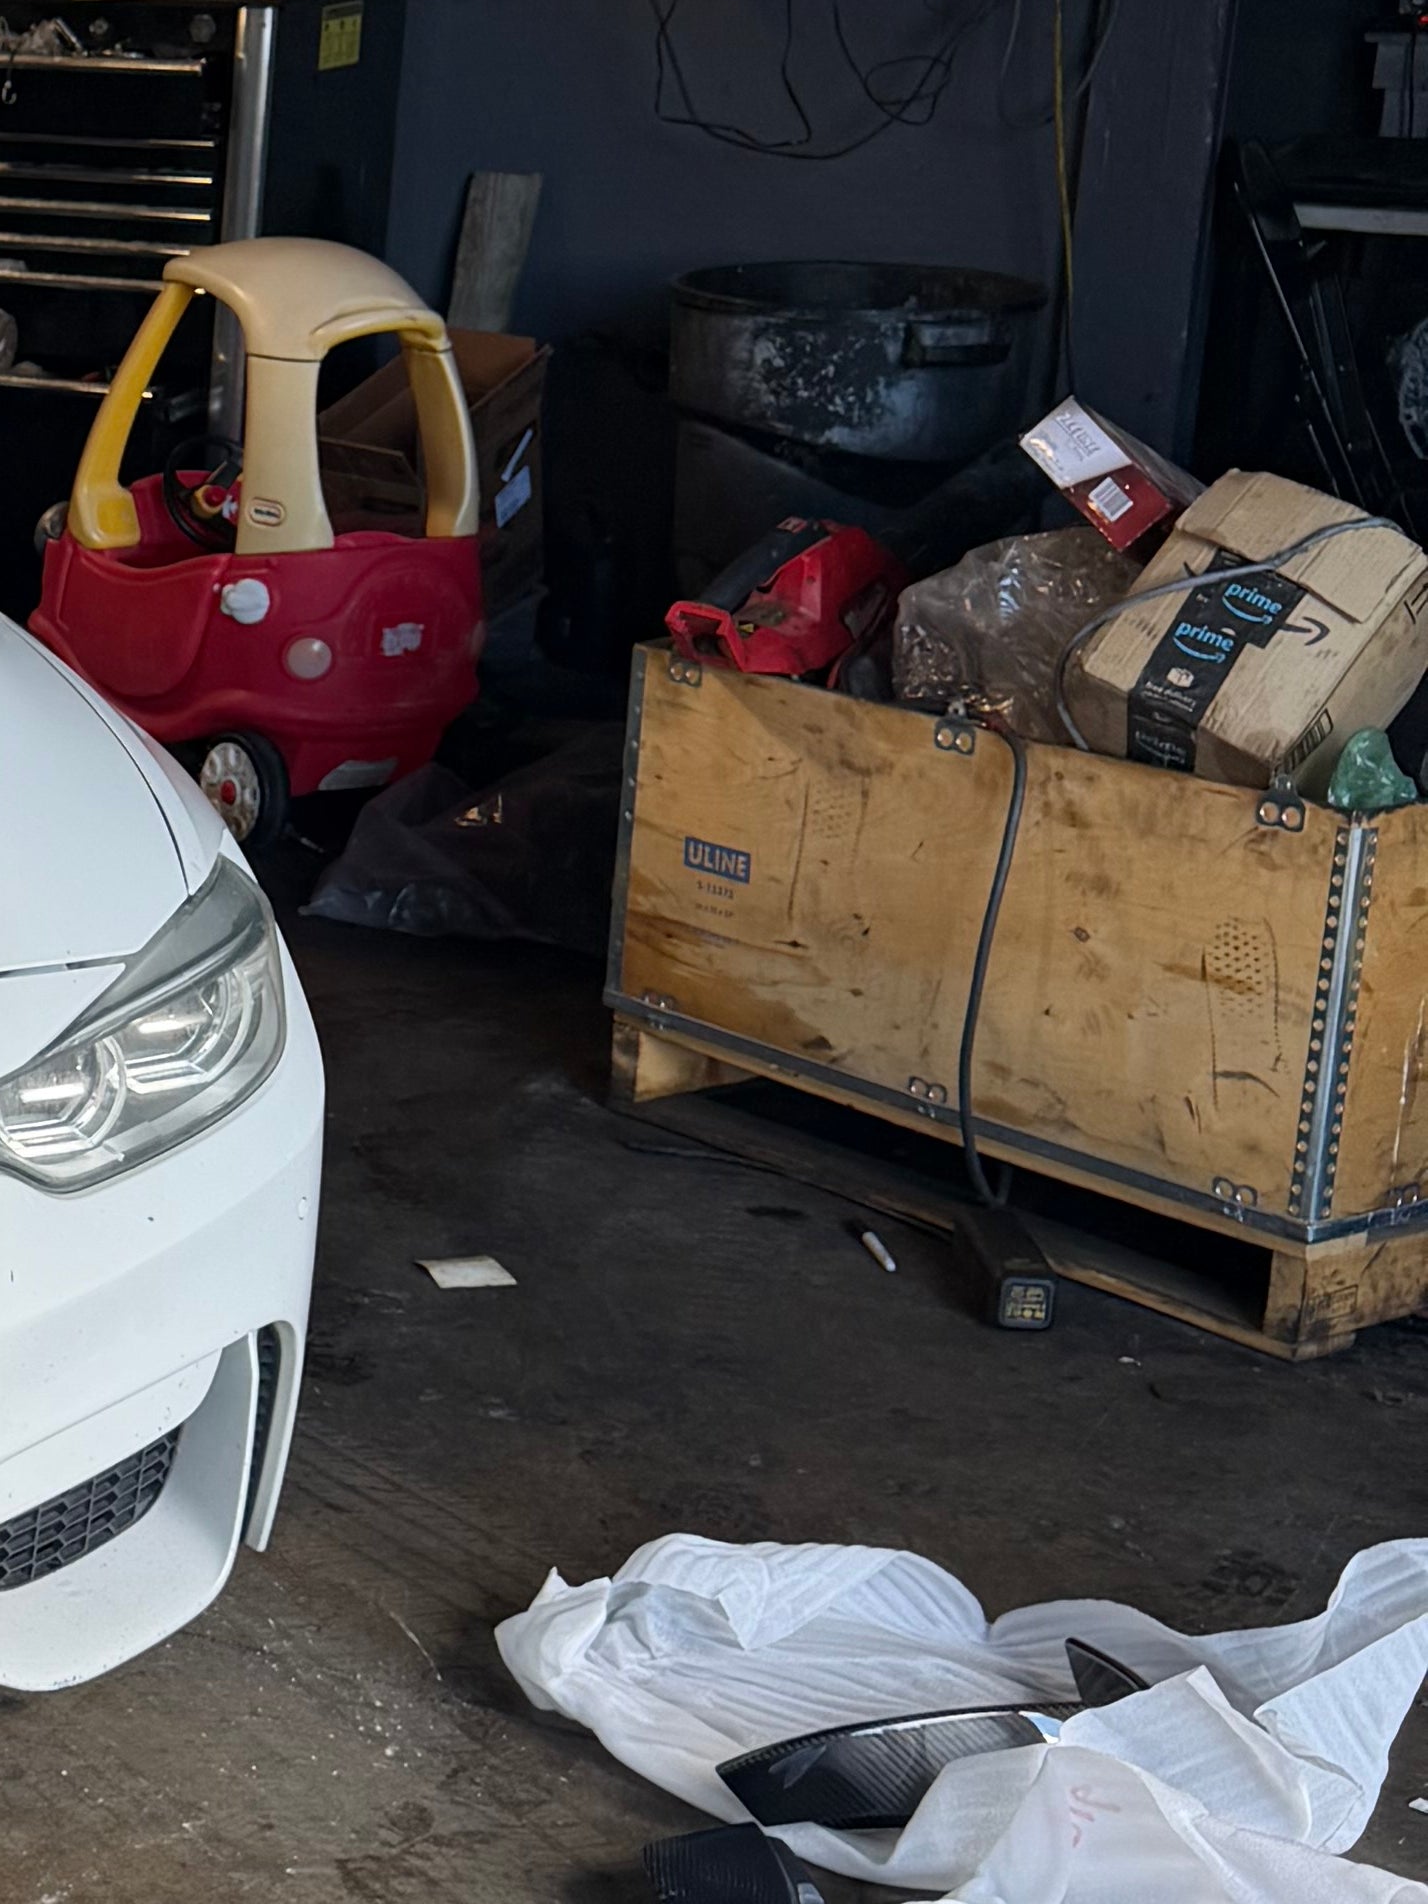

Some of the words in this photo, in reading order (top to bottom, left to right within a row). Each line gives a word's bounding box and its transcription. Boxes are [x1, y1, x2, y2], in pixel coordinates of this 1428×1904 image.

[1224, 582, 1283, 615] prime
[1174, 621, 1235, 653] prime
[688, 840, 747, 877] ULINE
